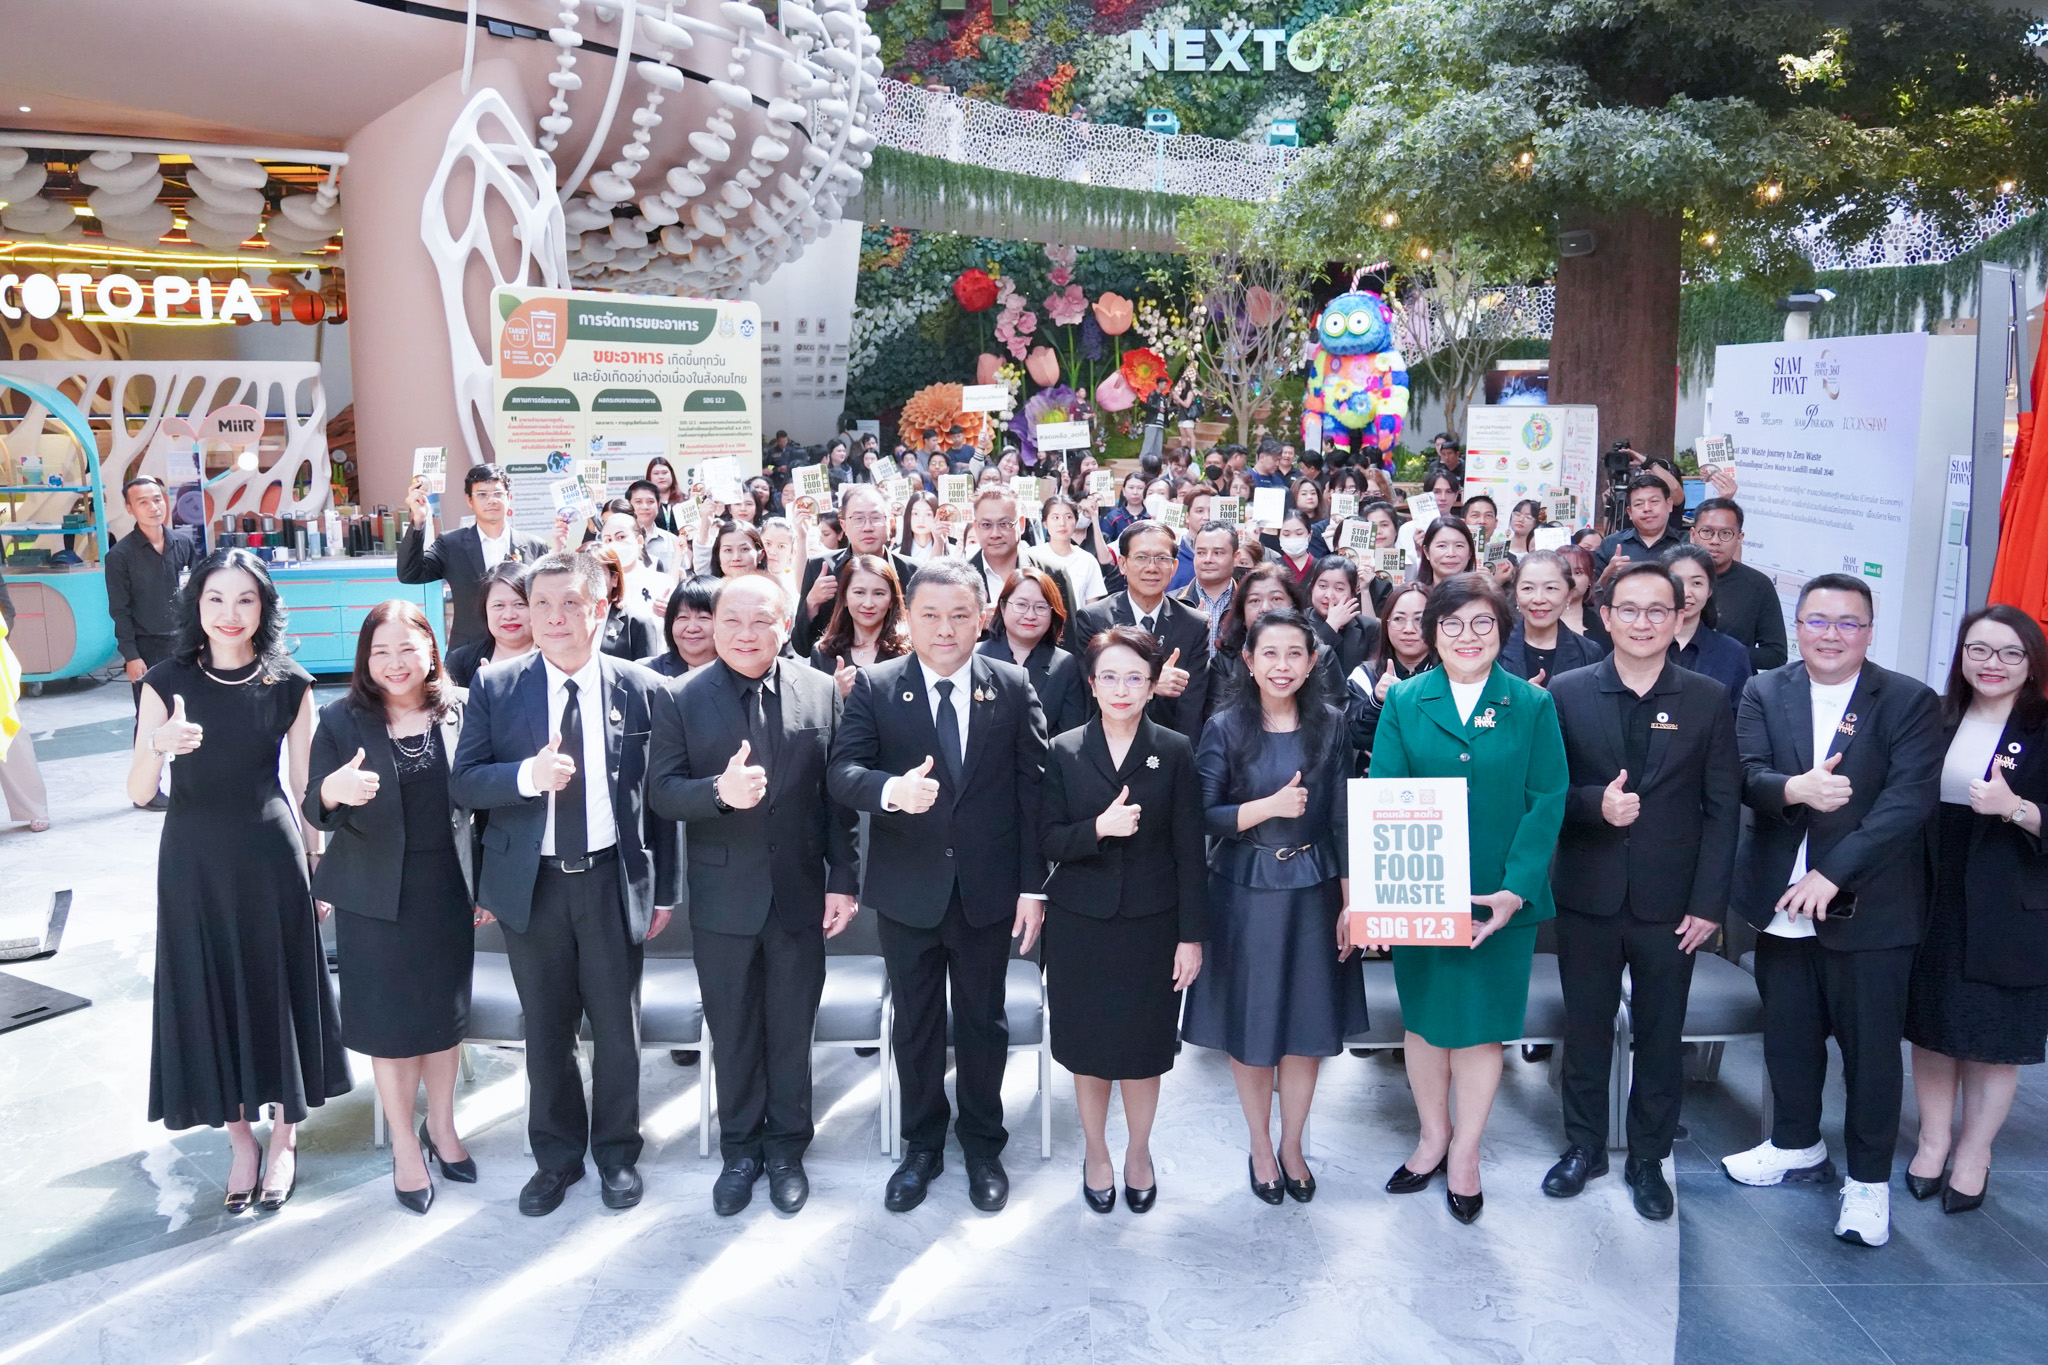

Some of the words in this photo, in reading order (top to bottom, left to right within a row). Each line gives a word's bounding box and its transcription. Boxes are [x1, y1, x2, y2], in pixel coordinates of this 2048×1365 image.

[579, 311, 699, 332] การจัดการขยะอาหาร
[537, 332, 552, 342] 50%
[504, 350, 510, 359] 12
[594, 350, 664, 364] ขยะอาหาร
[668, 350, 726, 369] เกิดขึ้นทุกวัน
[1774, 356, 1802, 374] SIAM
[574, 368, 748, 384] และยังเกิดอย่างต่อเนื่องในสังคมไทย
[1772, 376, 1808, 394] PIWAT
[1794, 418, 1806, 427] SIAM
[1843, 417, 1887, 431] ICONSIAM
[1752, 448, 1766, 456] Waste
[1767, 449, 1785, 460] Journey
[1793, 451, 1805, 459] Zero
[1806, 452, 1822, 460] Waste
[1951, 460, 1972, 473] SIAM
[803, 473, 819, 481] STOP
[1950, 473, 1971, 485] PIWA
[561, 484, 578, 494] STOP
[682, 505, 696, 514] STOP
[684, 512, 697, 520] FOOD
[1844, 555, 1856, 564] SIAM
[1843, 564, 1859, 574] PIWAT
[1994, 754, 2014, 764] SIAM
[1376, 808, 1411, 818] ลดเหลือ
[1414, 807, 1440, 818] ลดทิ้ง
[1373, 824, 1443, 851] STOP
[1374, 854, 1444, 881] FOOD
[1375, 884, 1445, 904] WASTE
[1366, 917, 1408, 939] SDG
[1413, 917, 1455, 939] 12.3
